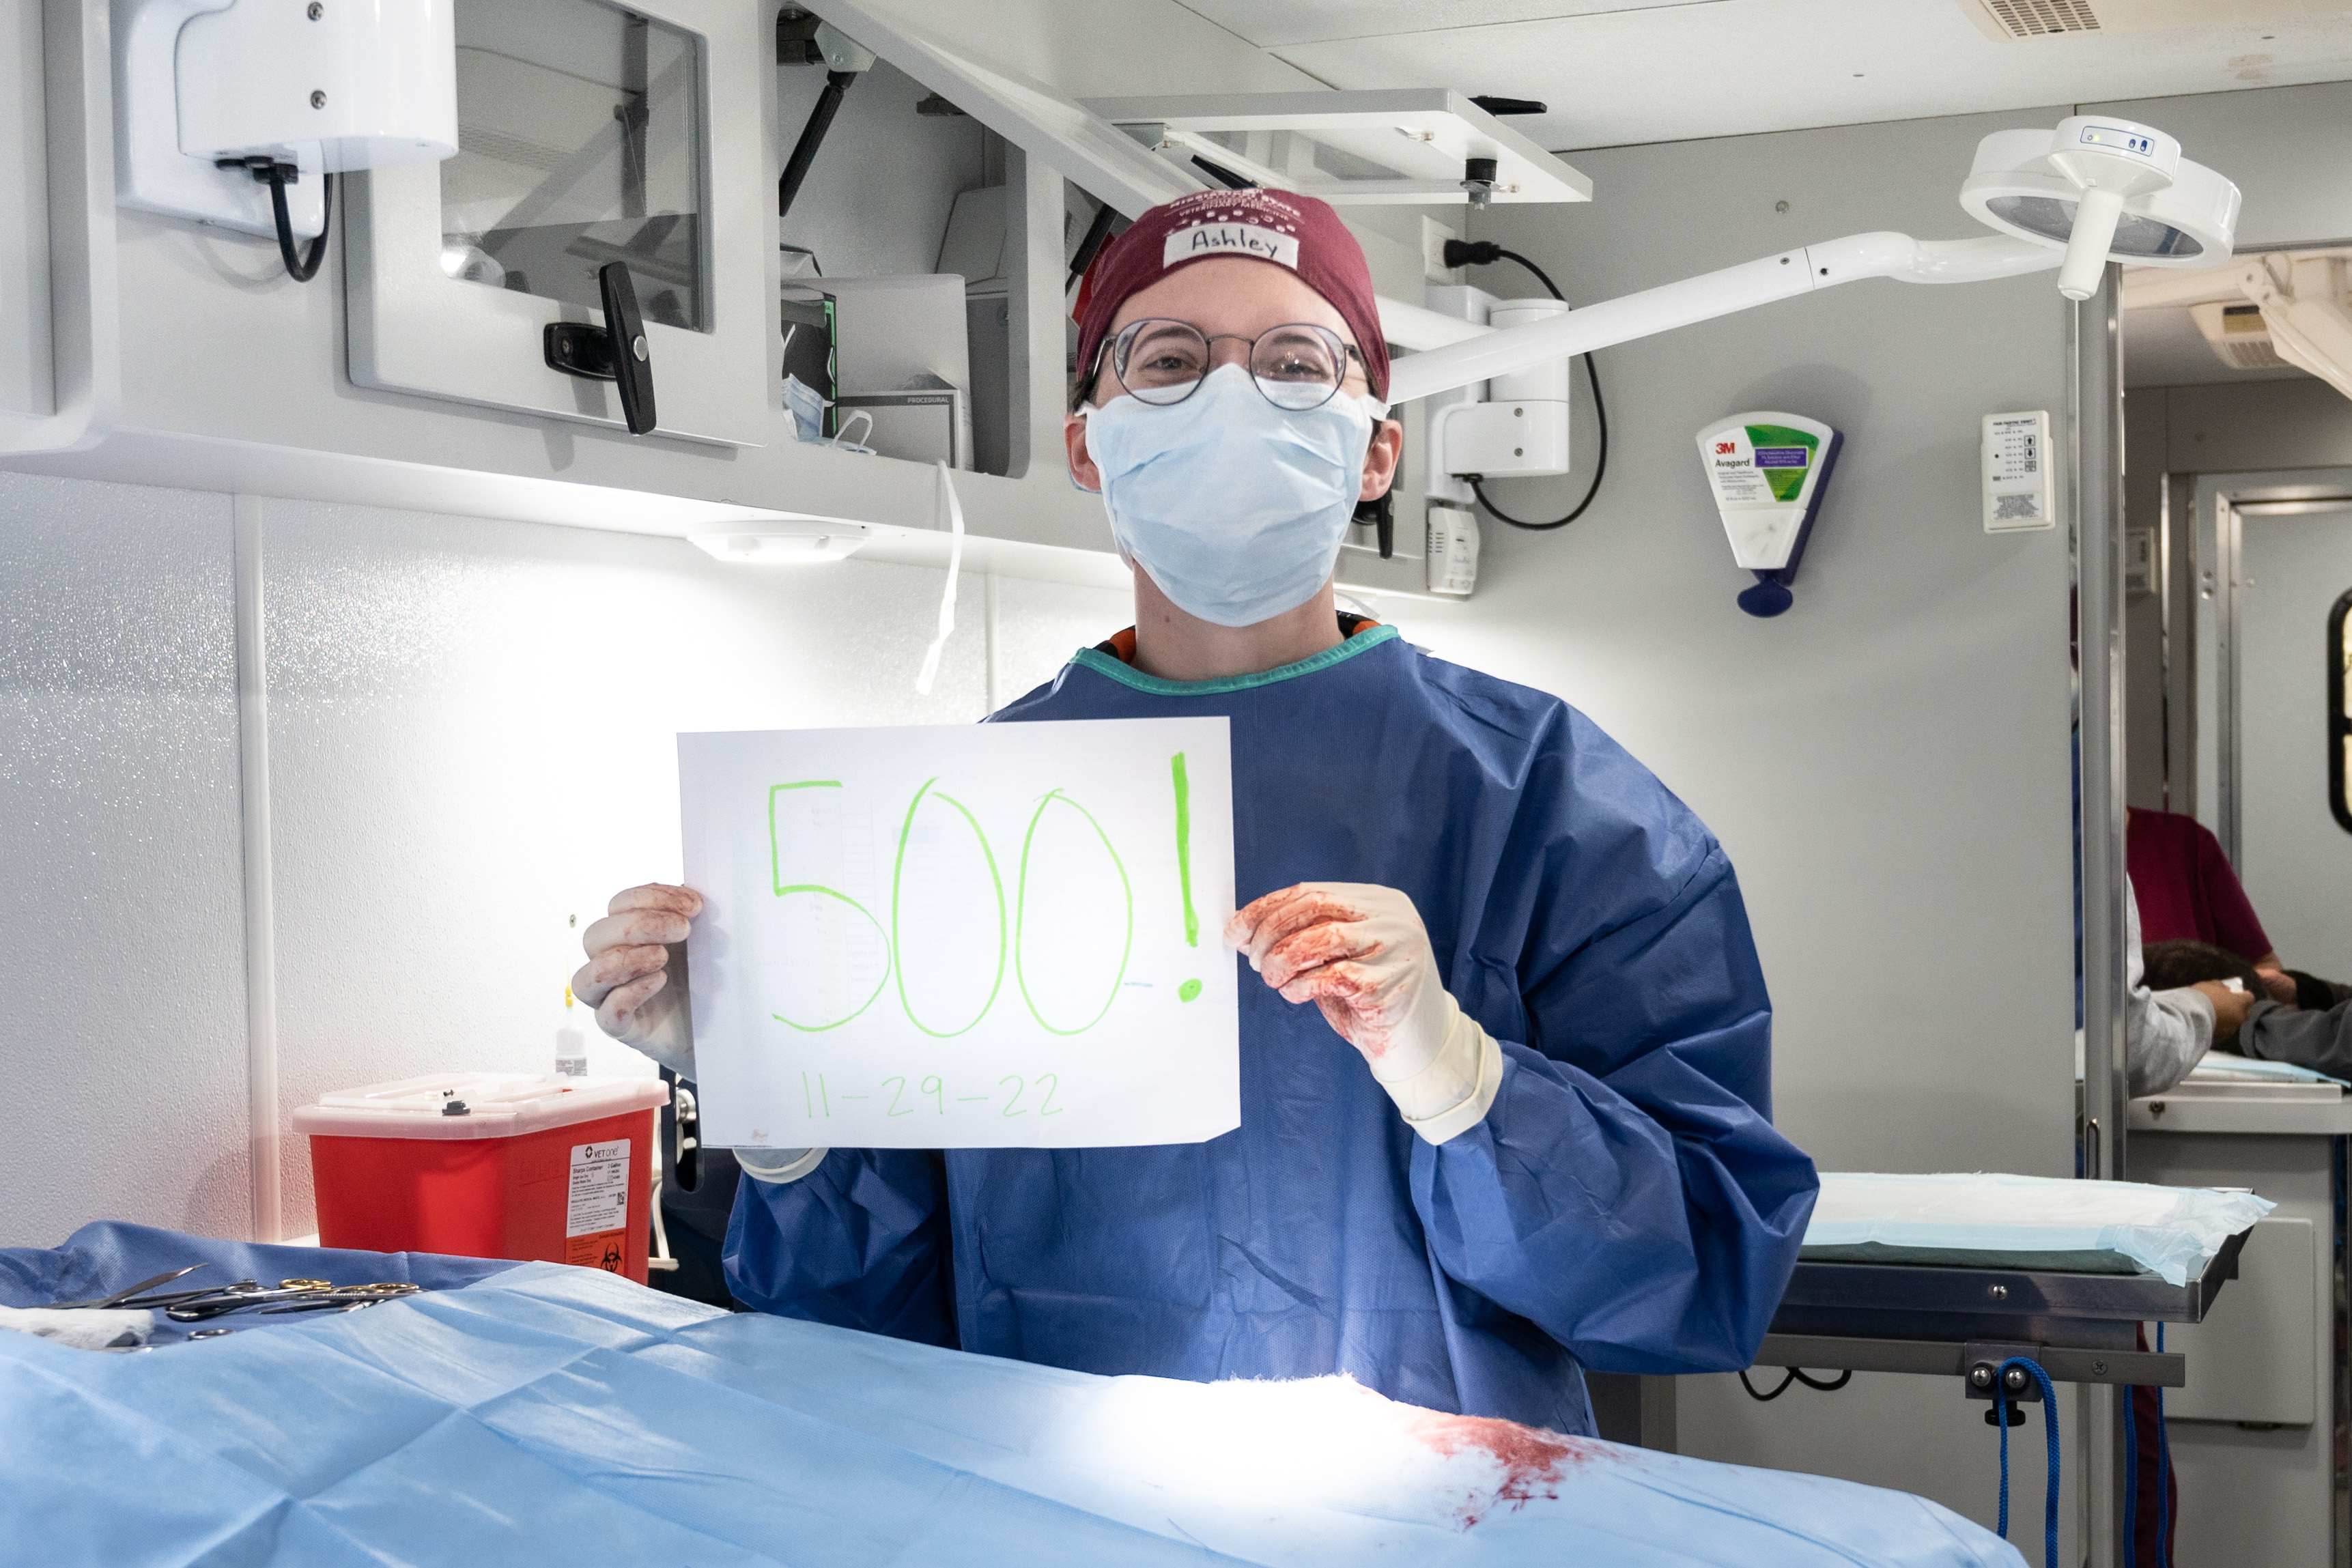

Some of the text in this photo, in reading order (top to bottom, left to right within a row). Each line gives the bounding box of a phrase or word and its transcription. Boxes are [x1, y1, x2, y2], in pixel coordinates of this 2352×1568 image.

[1192, 228, 1277, 258] Ashley
[1715, 442, 1735, 454] 3M
[1715, 459, 1750, 468] Avagard
[803, 1071, 1064, 1119] 11-29-22
